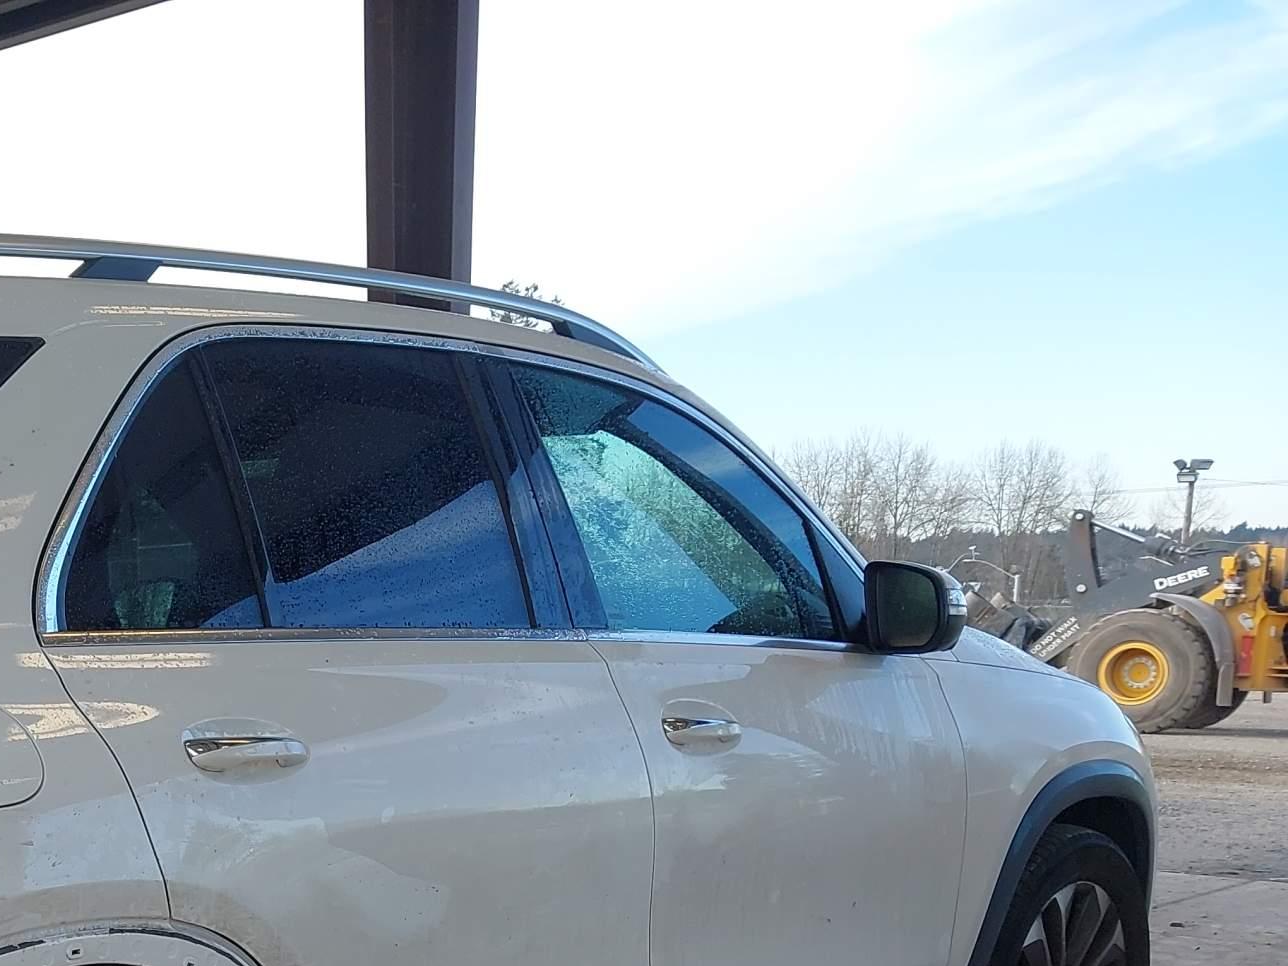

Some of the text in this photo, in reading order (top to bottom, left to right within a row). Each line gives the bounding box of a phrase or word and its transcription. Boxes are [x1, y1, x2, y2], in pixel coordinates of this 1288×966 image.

[1153, 566, 1210, 590] DEERE
[1030, 616, 1078, 655] DO NOT WALK
